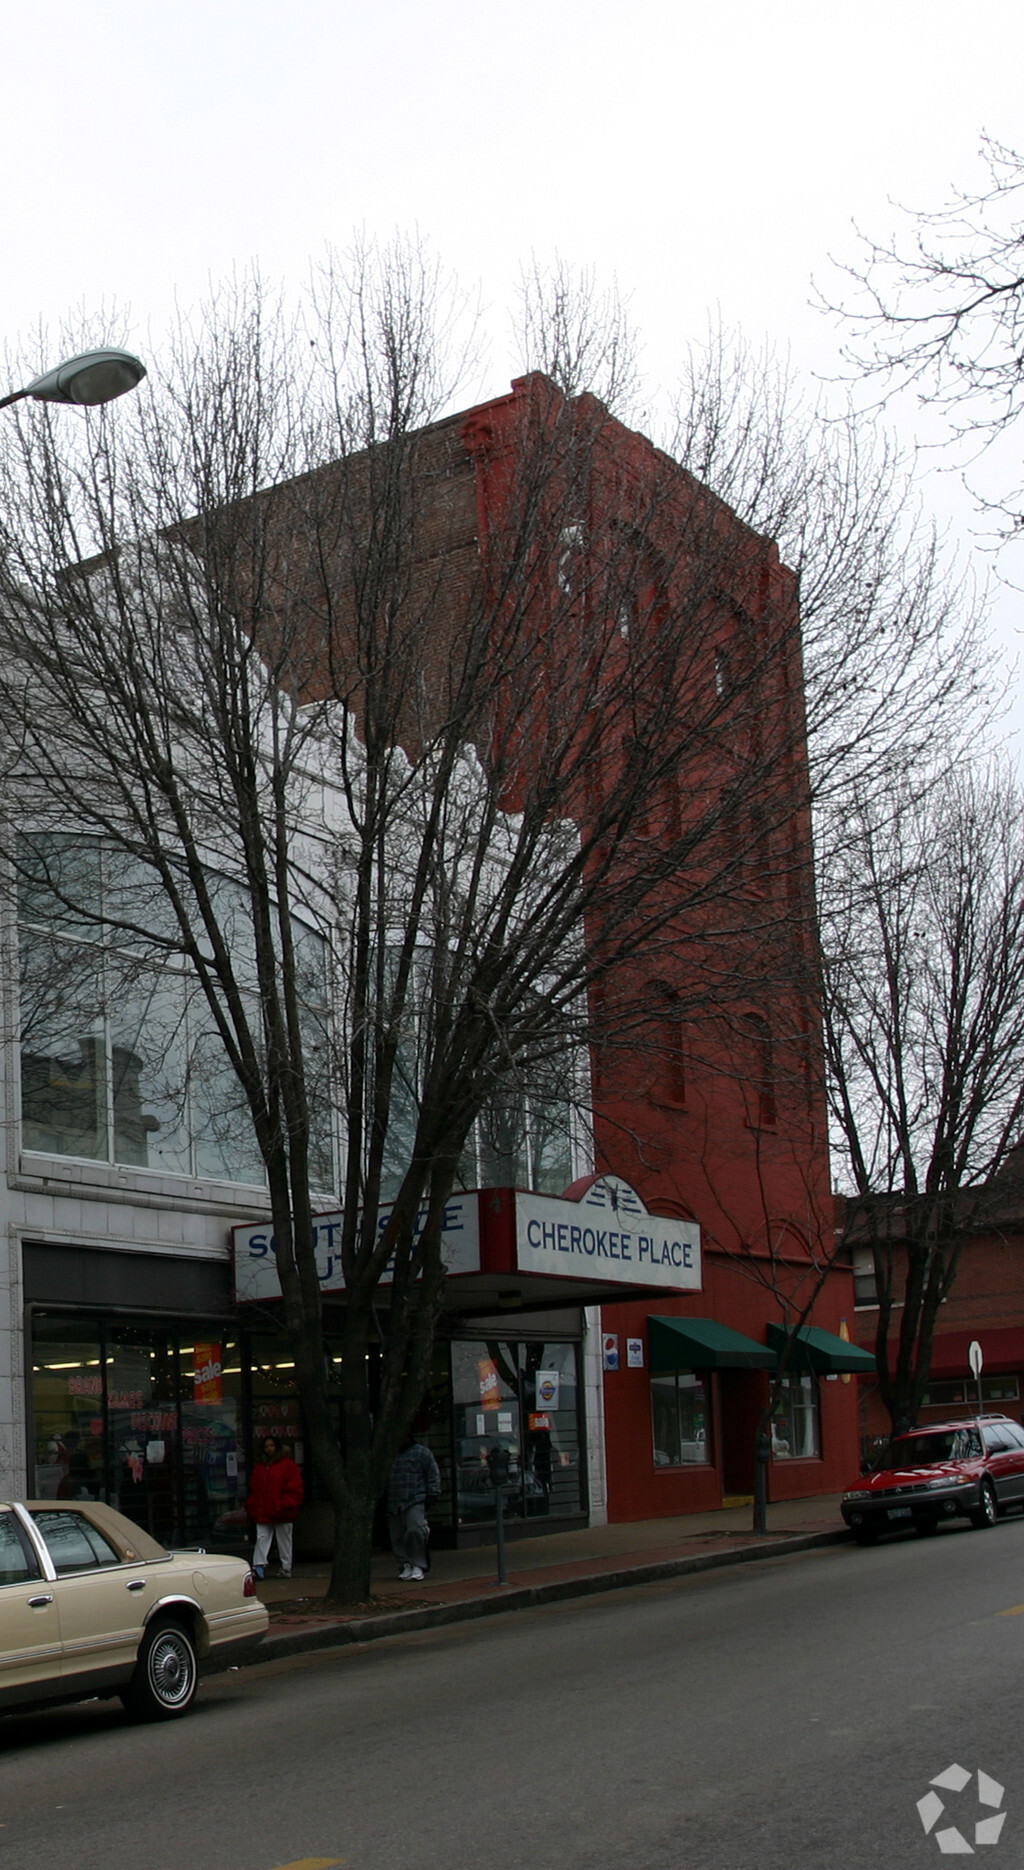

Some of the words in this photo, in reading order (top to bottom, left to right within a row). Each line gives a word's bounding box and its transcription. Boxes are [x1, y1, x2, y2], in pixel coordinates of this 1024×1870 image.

[527, 1219, 632, 1260] CHEROKEE
[638, 1236, 694, 1268] PLACE
[194, 1359, 222, 1384] sale
